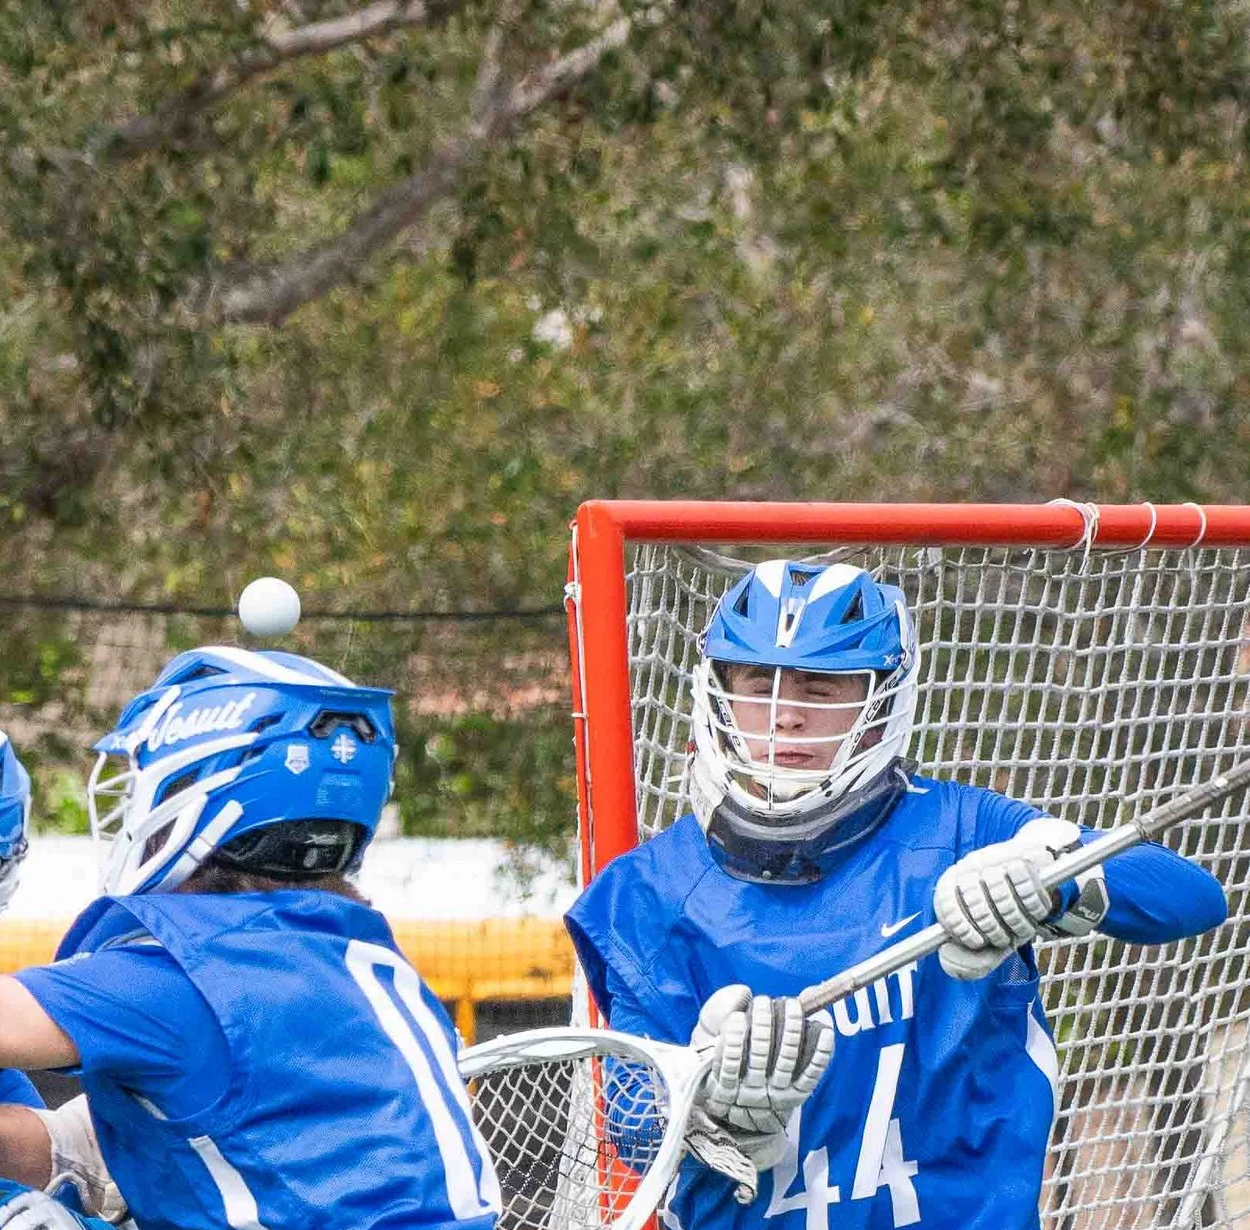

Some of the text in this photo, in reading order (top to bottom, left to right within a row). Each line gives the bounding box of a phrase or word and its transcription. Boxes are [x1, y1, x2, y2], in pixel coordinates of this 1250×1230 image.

[130, 685, 257, 751] Jesuit
[810, 961, 918, 1036] uit
[345, 939, 502, 1221] 0
